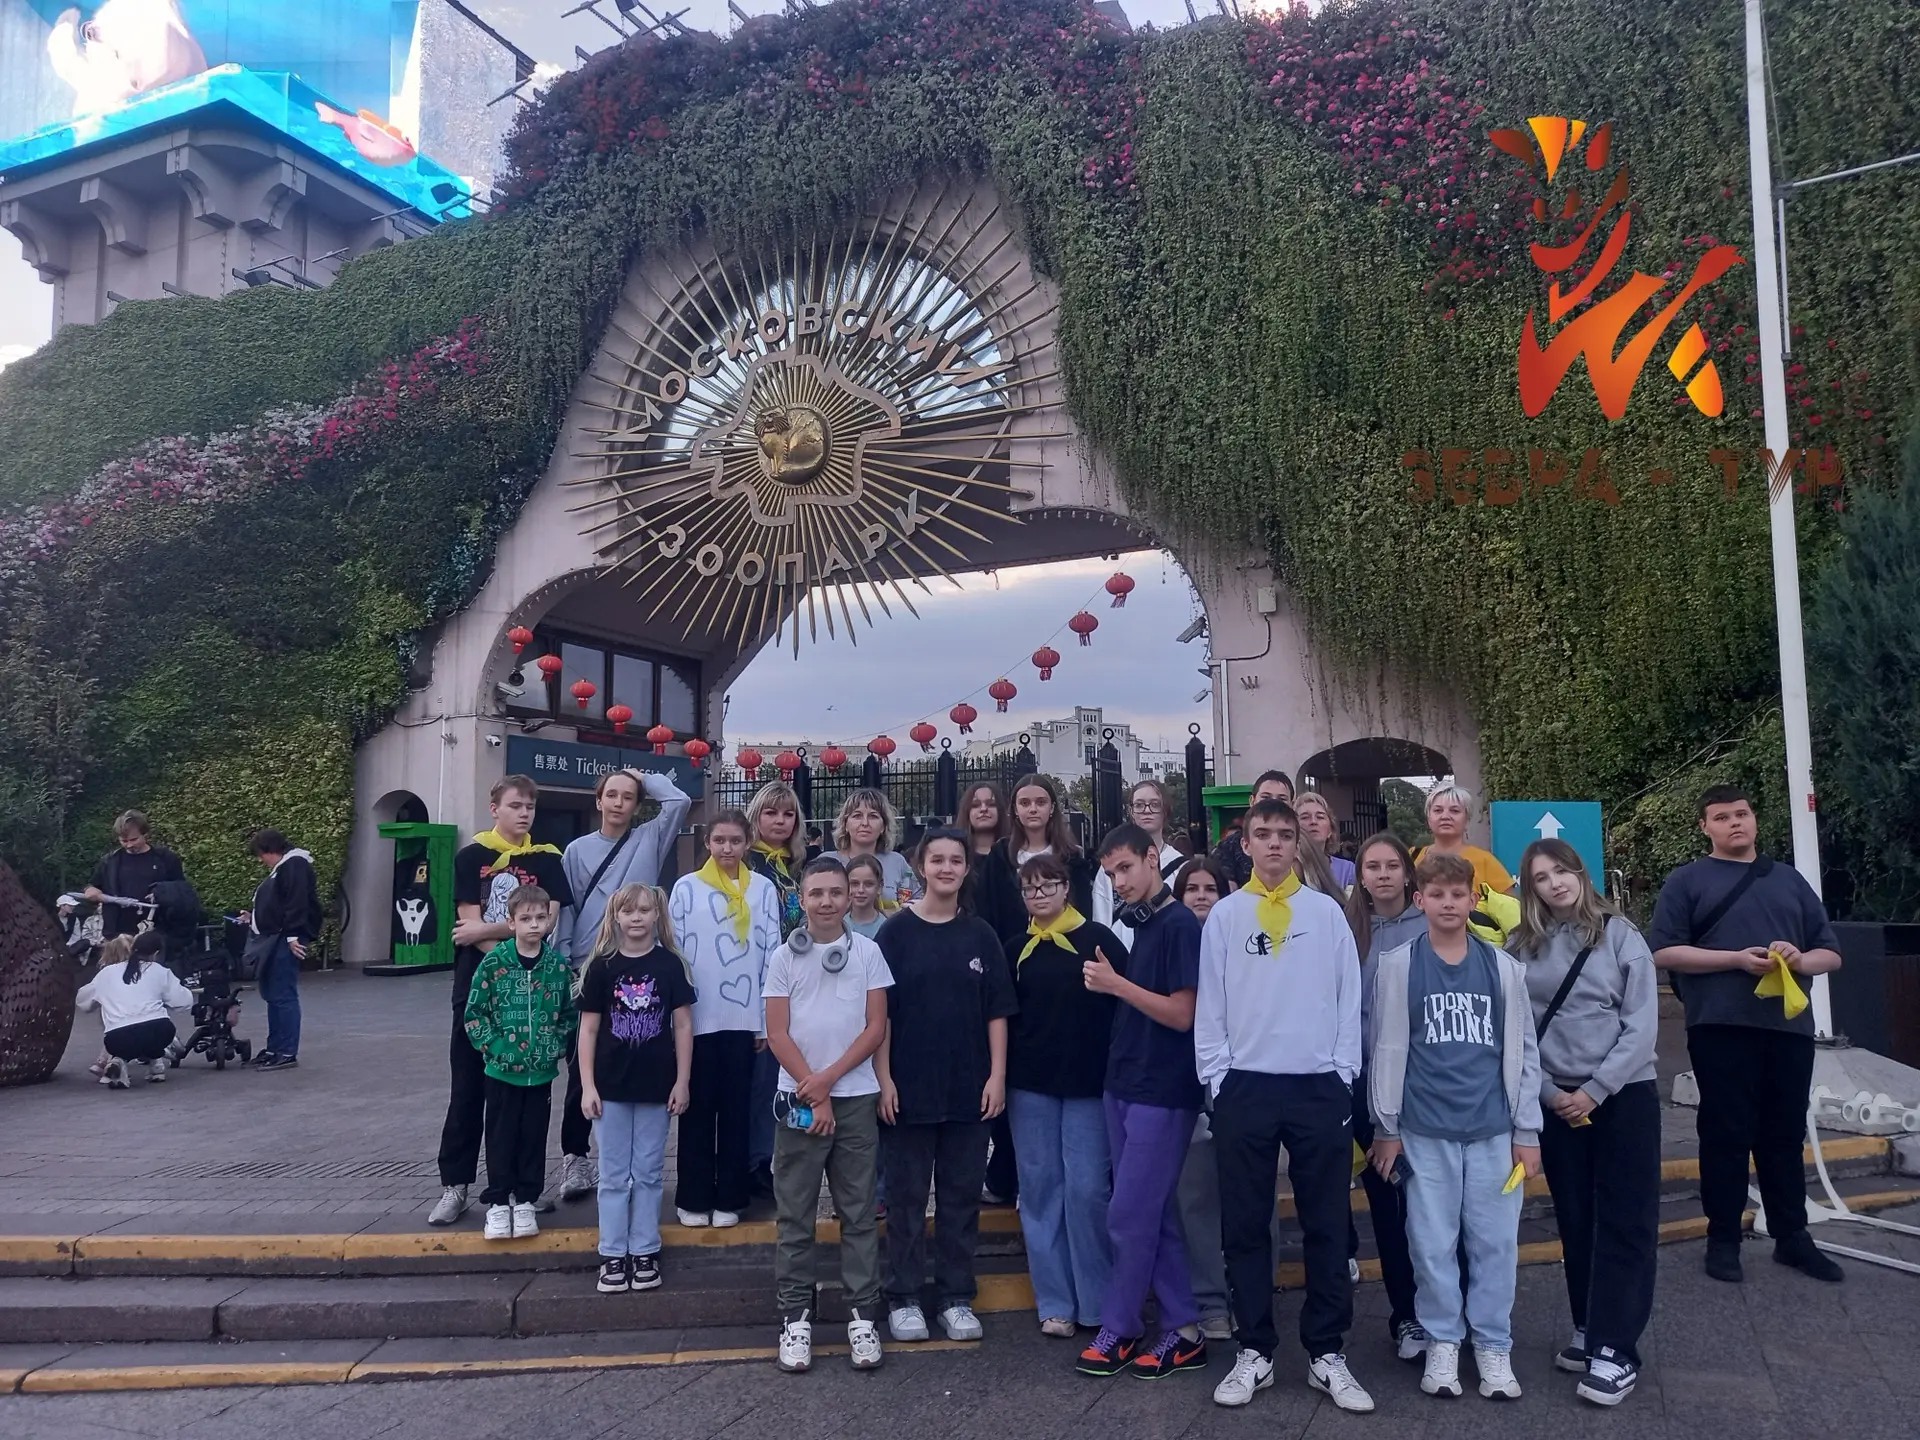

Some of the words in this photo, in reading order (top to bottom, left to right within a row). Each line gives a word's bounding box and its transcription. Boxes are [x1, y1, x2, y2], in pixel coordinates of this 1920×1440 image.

[659, 489, 931, 586] ЗООПАРК
[534, 753, 568, 771] 售票处
[576, 757, 617, 776] Tickets
[1424, 1008, 1494, 1047] ALONE
